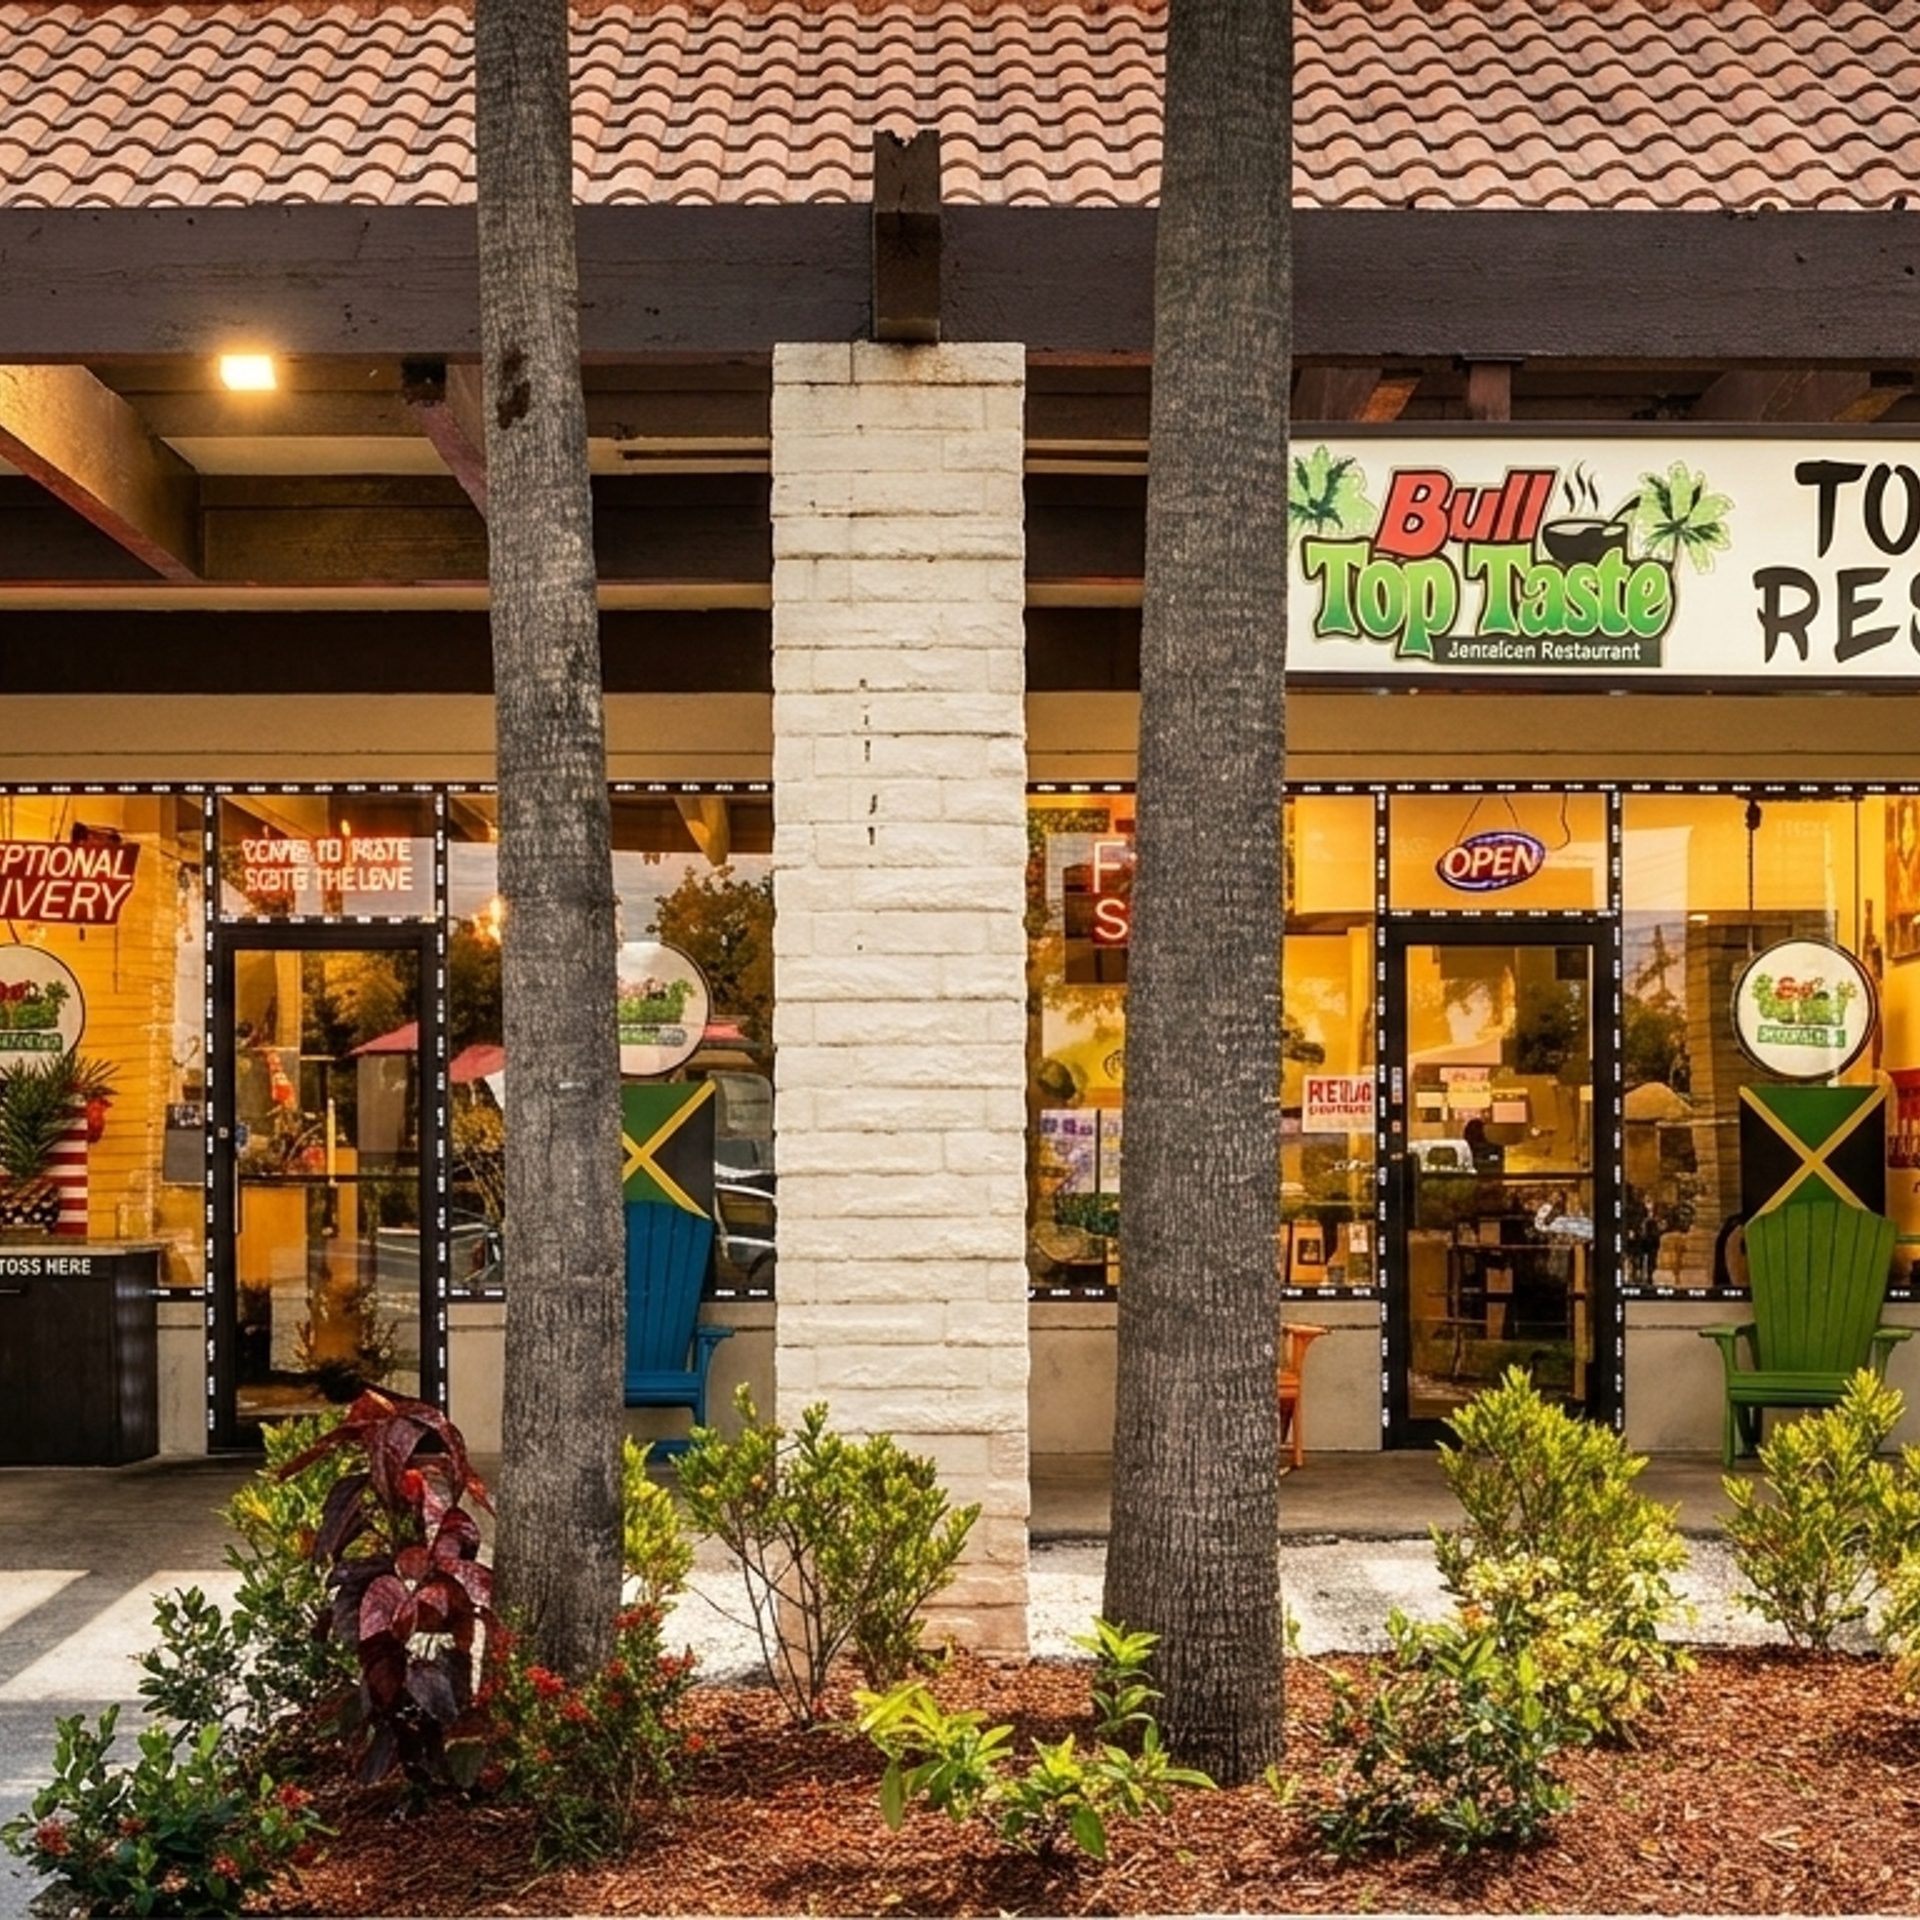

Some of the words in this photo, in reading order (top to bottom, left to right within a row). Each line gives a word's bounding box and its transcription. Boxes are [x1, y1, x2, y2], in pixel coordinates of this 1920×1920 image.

[1374, 470, 1559, 558] Bull
[1301, 537, 1460, 661] Top
[1465, 542, 1674, 639] Taste
[1752, 565, 1920, 663] RE
[1541, 641, 1641, 660] Restaurant
[0, 844, 131, 880] PTIONAL
[1444, 844, 1538, 878] OPEN
[46, 1257, 91, 1275] HERE
